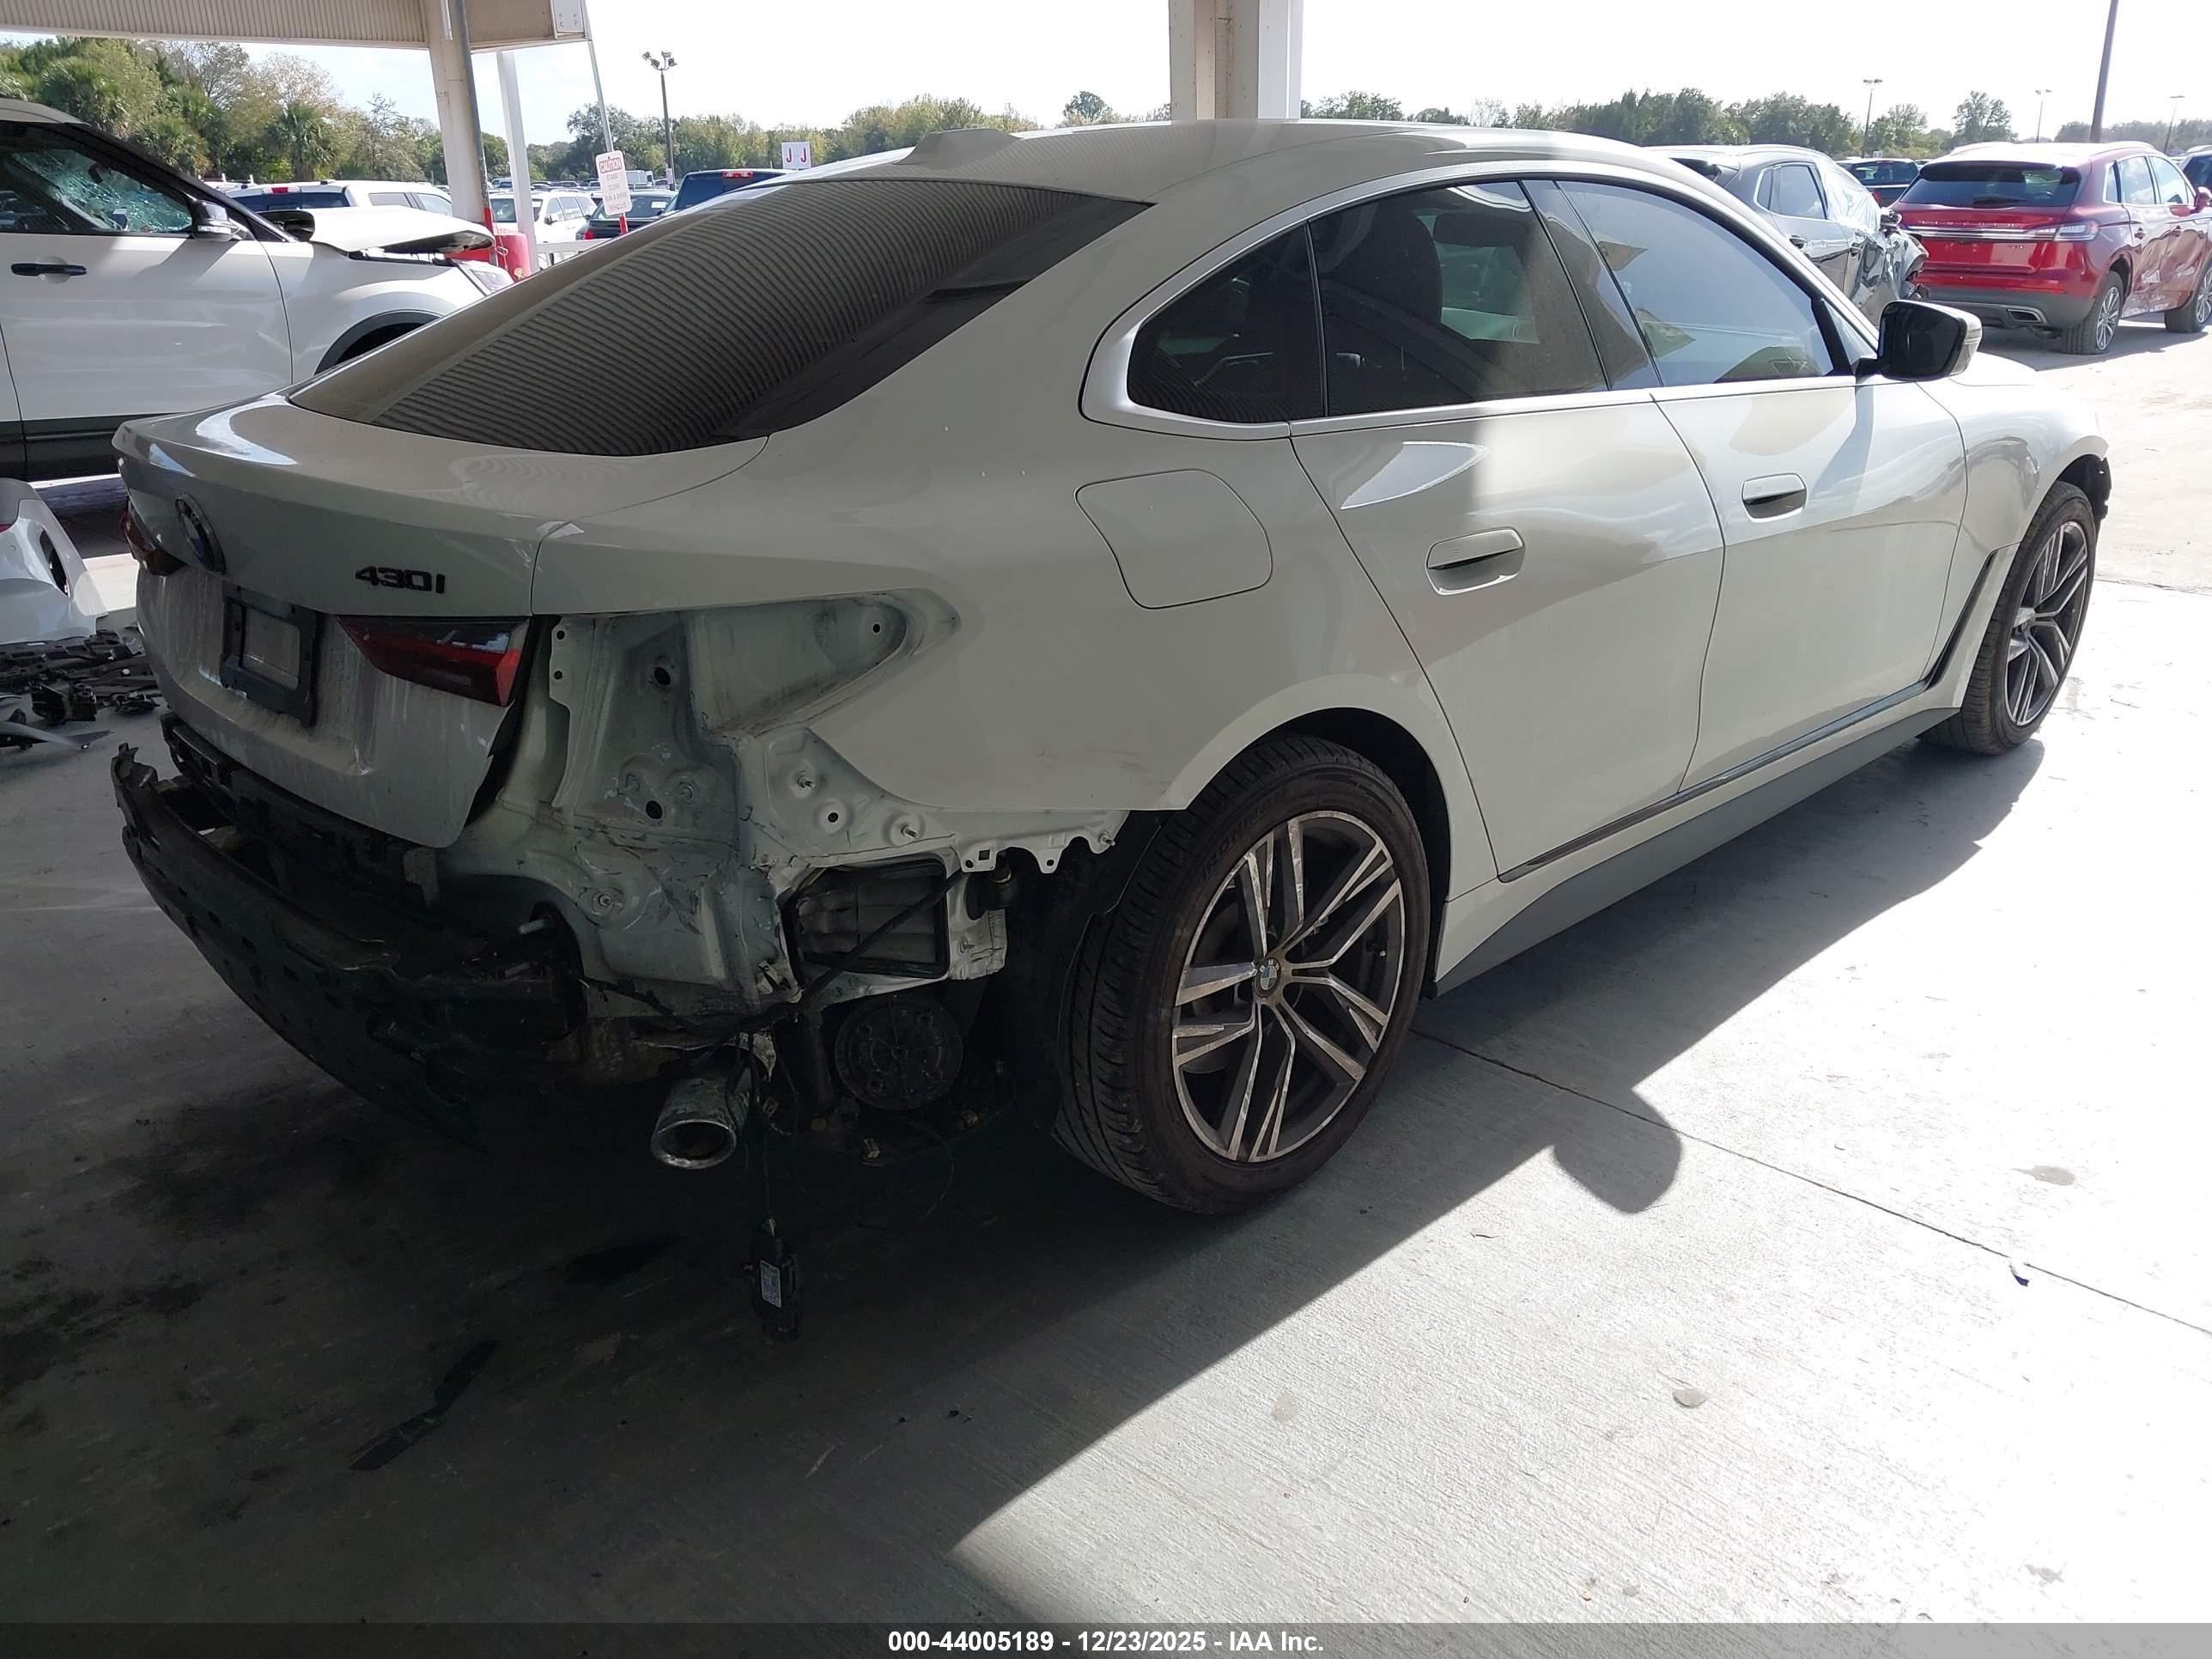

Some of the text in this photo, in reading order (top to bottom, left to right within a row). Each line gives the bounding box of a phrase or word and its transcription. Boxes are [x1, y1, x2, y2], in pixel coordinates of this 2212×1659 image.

[786, 147, 807, 163] J J
[599, 157, 623, 173] CAUTION
